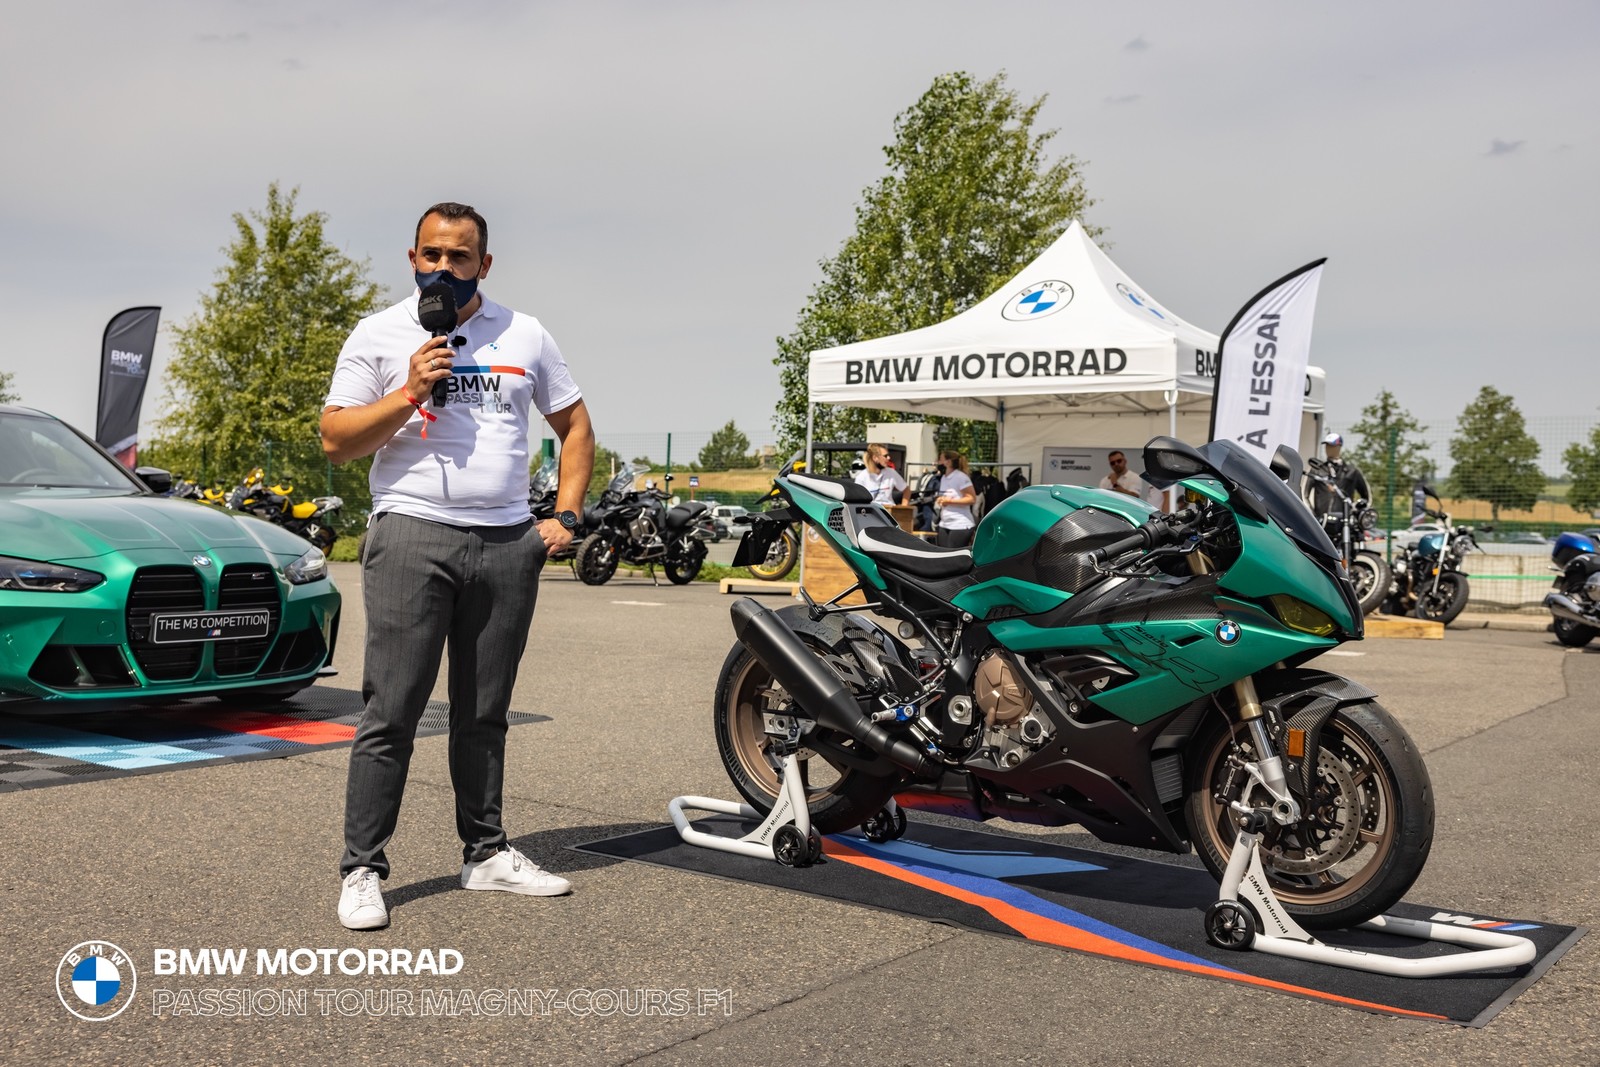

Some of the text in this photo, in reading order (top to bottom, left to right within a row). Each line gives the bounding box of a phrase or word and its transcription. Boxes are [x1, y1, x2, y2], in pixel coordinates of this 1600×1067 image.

[111, 349, 143, 364] BMW
[845, 347, 1127, 385] BMW MOTORRAD
[1196, 349, 1219, 378] BM
[1237, 313, 1281, 450] À L'ESSAI
[446, 392, 502, 404] PASSION
[477, 403, 512, 413] TOUR
[159, 614, 267, 630] THE M3 COMPETITION
[760, 800, 790, 841] BMW Motorrad
[1248, 875, 1289, 934] BMW Motorrad
